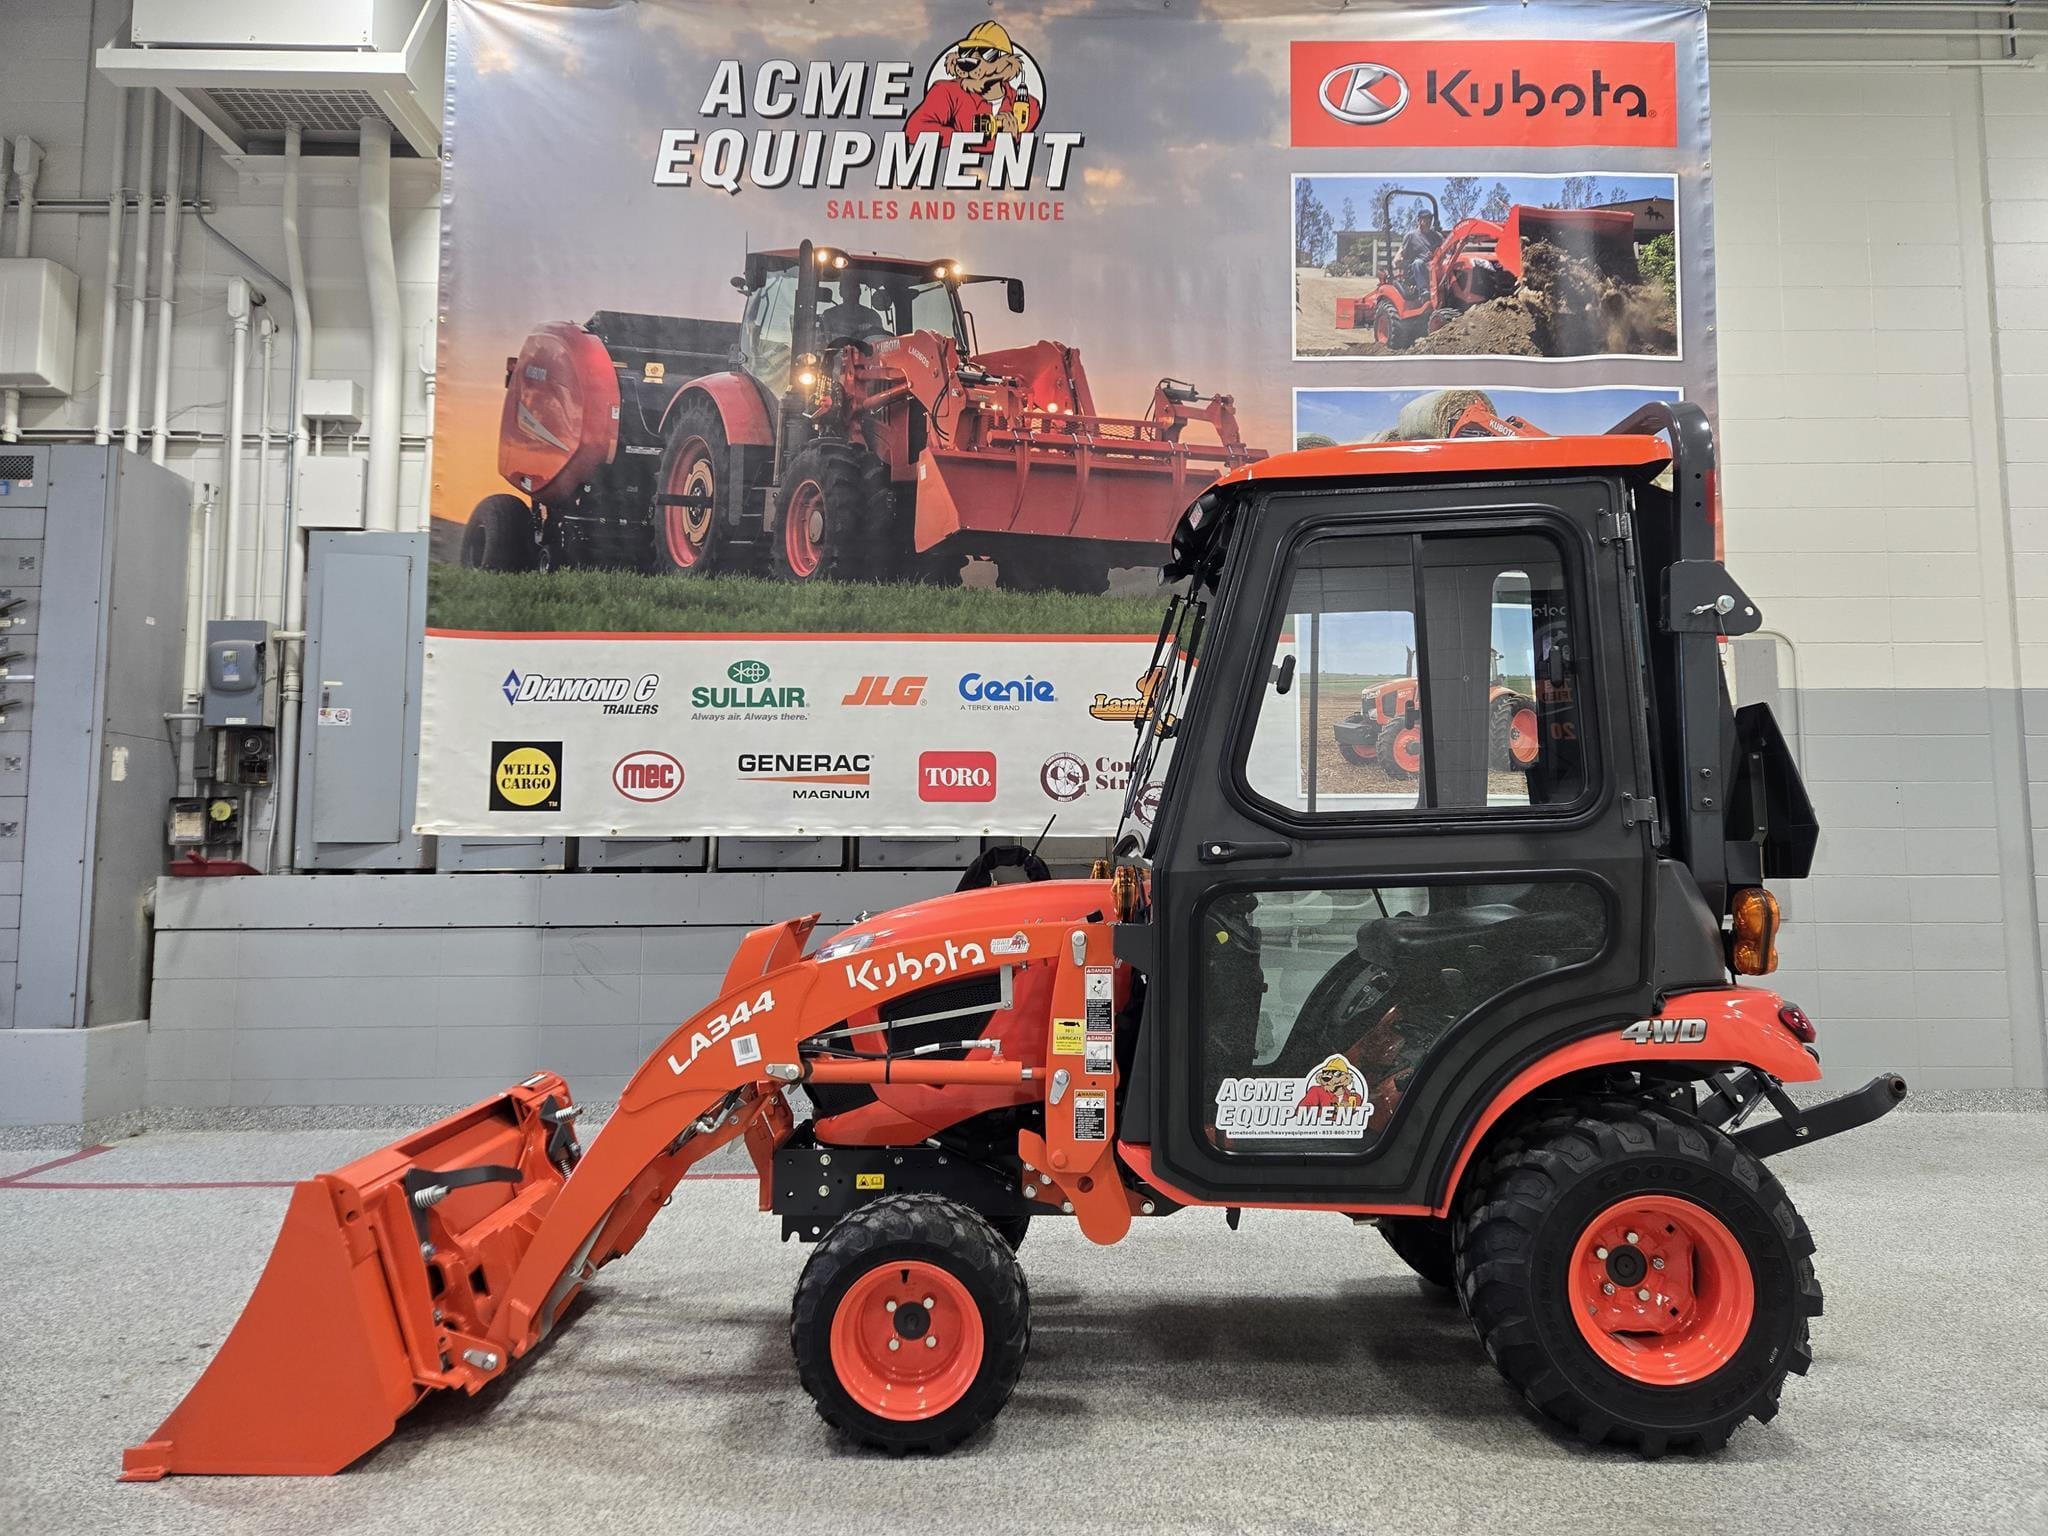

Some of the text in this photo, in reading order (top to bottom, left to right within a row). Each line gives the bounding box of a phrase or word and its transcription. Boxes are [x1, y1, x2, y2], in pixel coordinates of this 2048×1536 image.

[700, 59, 914, 119] ACME
[1426, 68, 1648, 118] Kubota
[652, 128, 1086, 194] EQUIPMENT
[826, 200, 1065, 221] SALES AND SERVICE
[516, 674, 659, 702] DIAMOND C
[691, 687, 805, 709] SULLAIR
[841, 676, 928, 706] JLG
[959, 672, 1054, 702] Genie
[602, 704, 659, 715] TRAILERS
[691, 713, 808, 722] Always air. Always there.
[503, 764, 551, 776] WELLS
[737, 754, 871, 772] GENERAC
[501, 778, 551, 790] CARGO
[925, 767, 990, 787] TORO
[792, 790, 870, 799] MAGNUM
[846, 939, 986, 992] Kubota
[667, 990, 776, 1076] LA344
[1620, 1018, 1708, 1044] 4WD
[1219, 1080, 1295, 1102] ACME
[1219, 1105, 1371, 1128] EQUIPMENT
